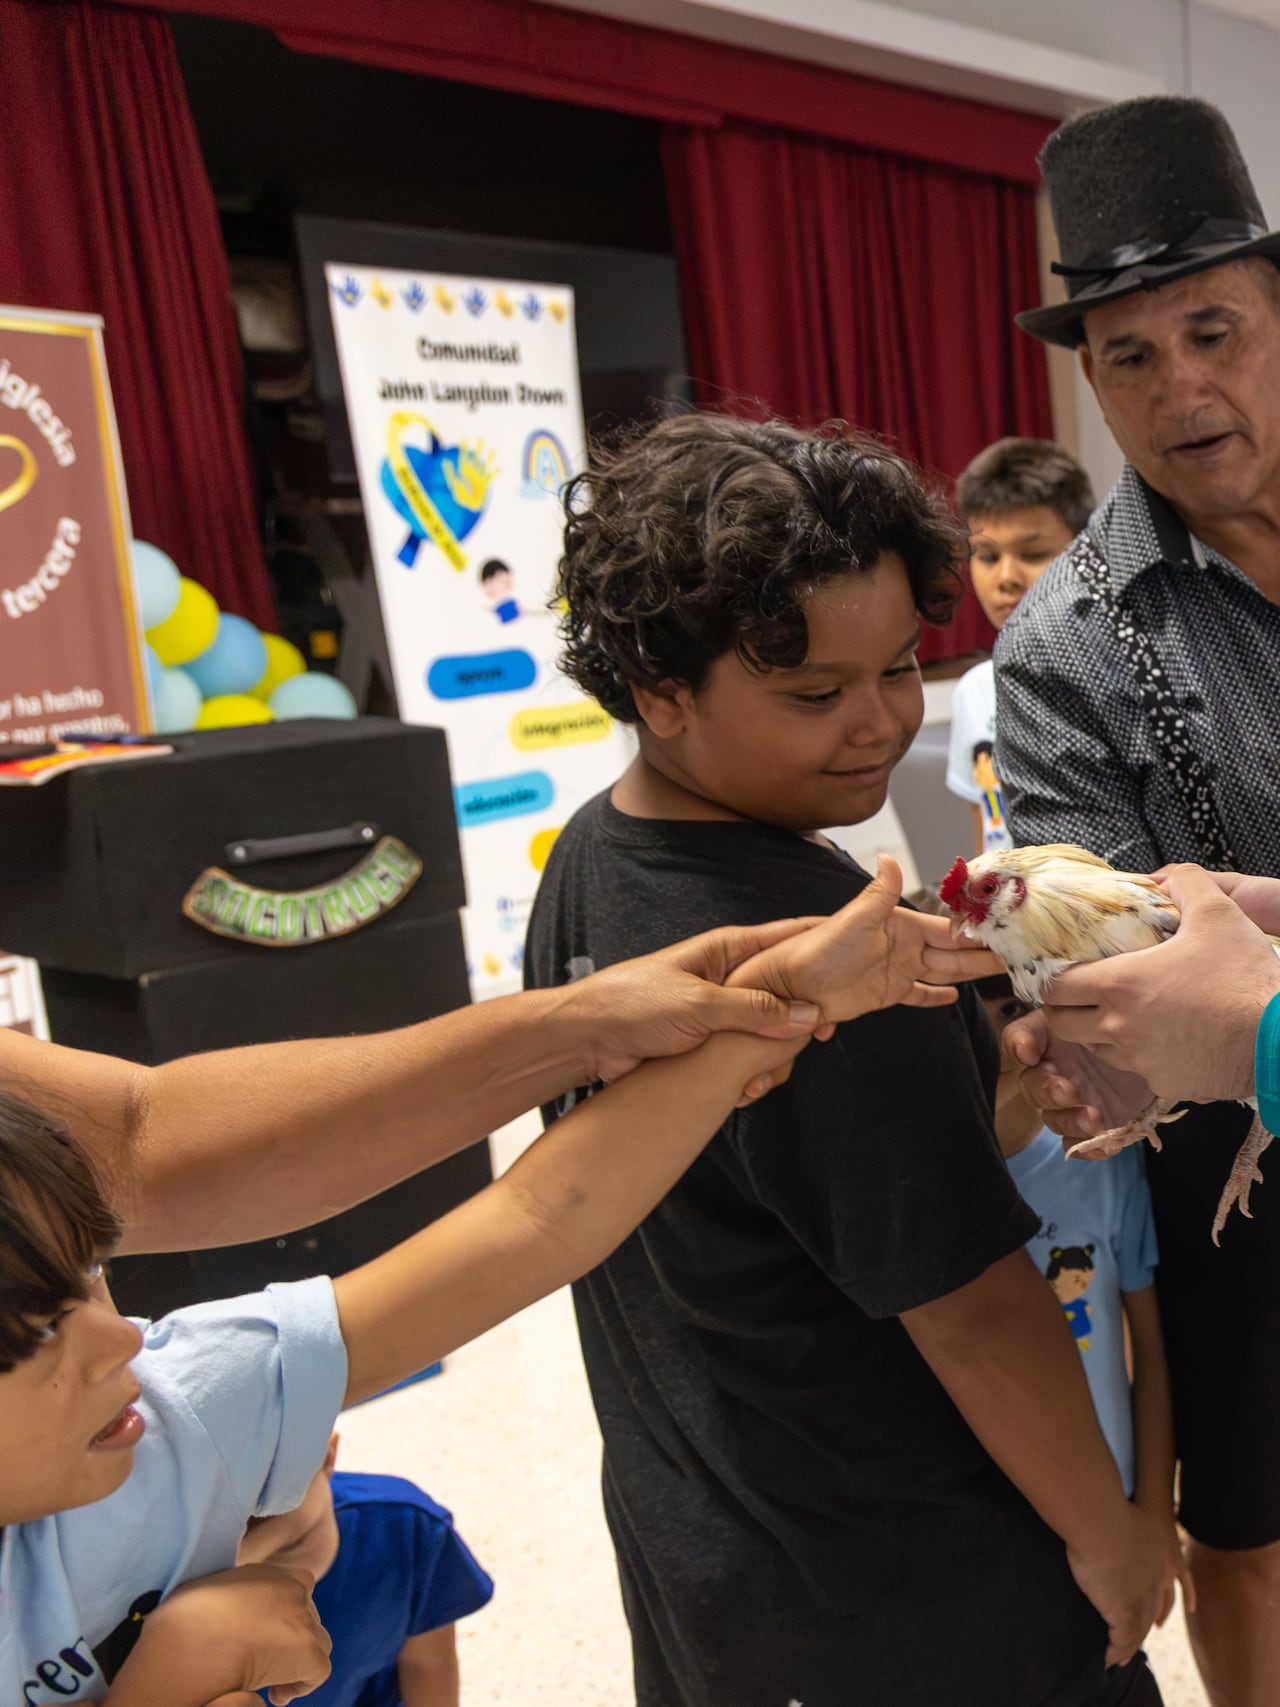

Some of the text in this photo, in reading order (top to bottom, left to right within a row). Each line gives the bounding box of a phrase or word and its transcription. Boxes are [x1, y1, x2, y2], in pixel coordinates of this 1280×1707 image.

[416, 336, 521, 366] Comunidad
[379, 377, 566, 413] John Langdon Down
